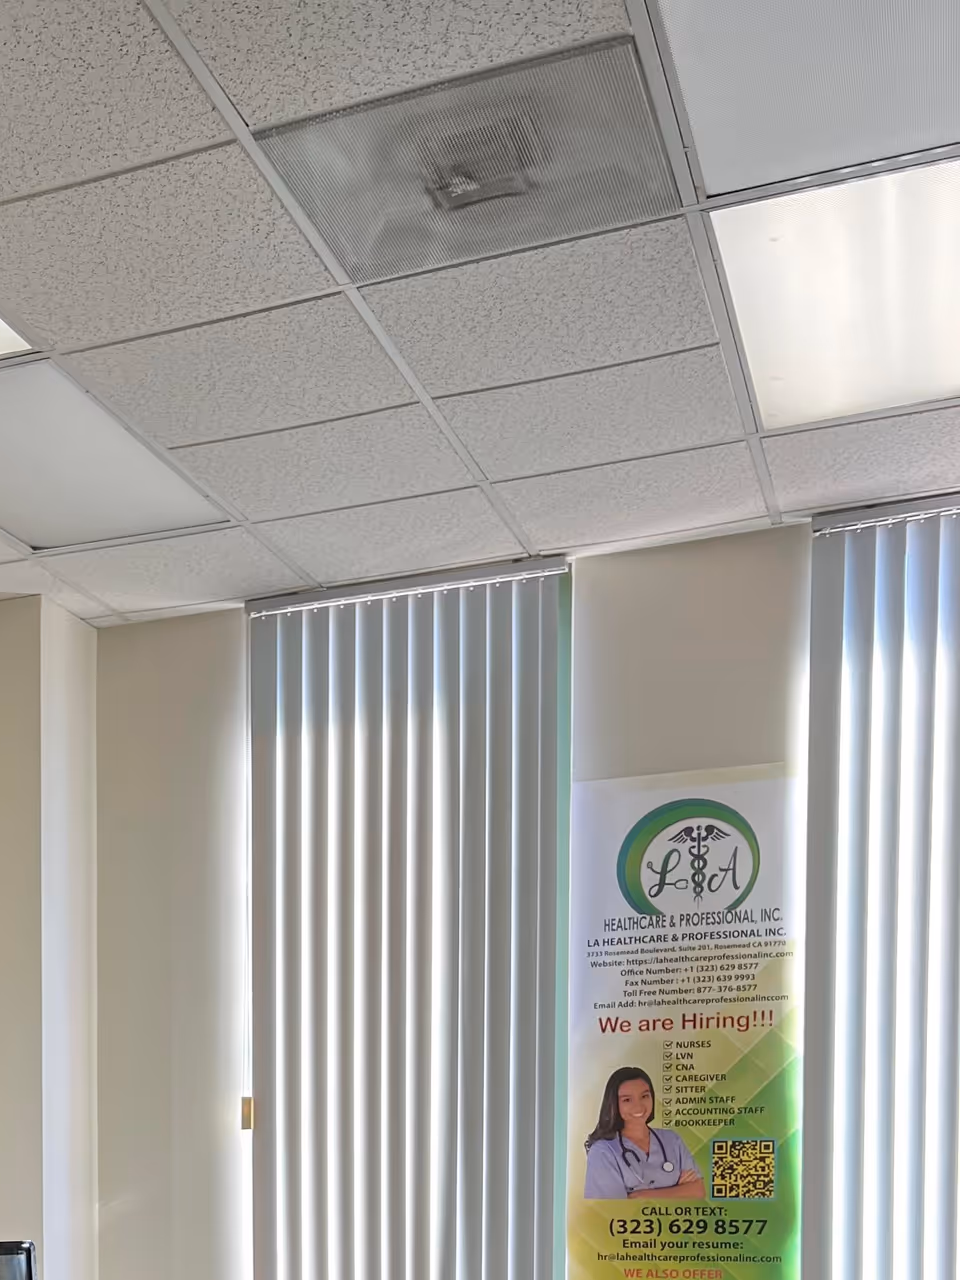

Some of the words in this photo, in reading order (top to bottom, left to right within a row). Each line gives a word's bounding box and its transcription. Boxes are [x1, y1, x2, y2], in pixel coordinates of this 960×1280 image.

[604, 914, 666, 932] HEALTHCARE
[669, 915, 676, 928] &
[679, 910, 757, 928] PROFESSIONAL,
[760, 908, 783, 922] INC.
[603, 934, 668, 946] HEALTHCARE
[682, 929, 762, 940] PROFESSIONAL
[765, 928, 786, 936] INC.
[646, 967, 681, 975] Number:
[697, 965, 717, 973] (323)
[693, 975, 714, 983] (323)
[717, 984, 757, 992] 376-8577
[599, 1017, 631, 1033] We
[639, 1018, 673, 1031] are
[682, 1009, 773, 1032] Hiring!!!
[676, 1040, 711, 1049] NURSES
[676, 1052, 693, 1060] LVN
[675, 1063, 694, 1071] CNA
[675, 1074, 727, 1083] CAREGIVER
[675, 1108, 735, 1116] ACCOUNTING
[675, 1119, 735, 1127] BOOKKEEPER
[642, 1207, 672, 1216] CALL
[675, 1207, 692, 1216] OR
[695, 1207, 728, 1216] TEXT:
[609, 1219, 662, 1237] (323)
[669, 1220, 707, 1234] 629
[714, 1220, 768, 1235] 8577
[622, 1239, 656, 1249] Email
[660, 1241, 689, 1251] your
[692, 1241, 743, 1250] resume:
[624, 1269, 642, 1278] WE
[646, 1269, 679, 1279] ALSO
[682, 1269, 722, 1279] OFFER
